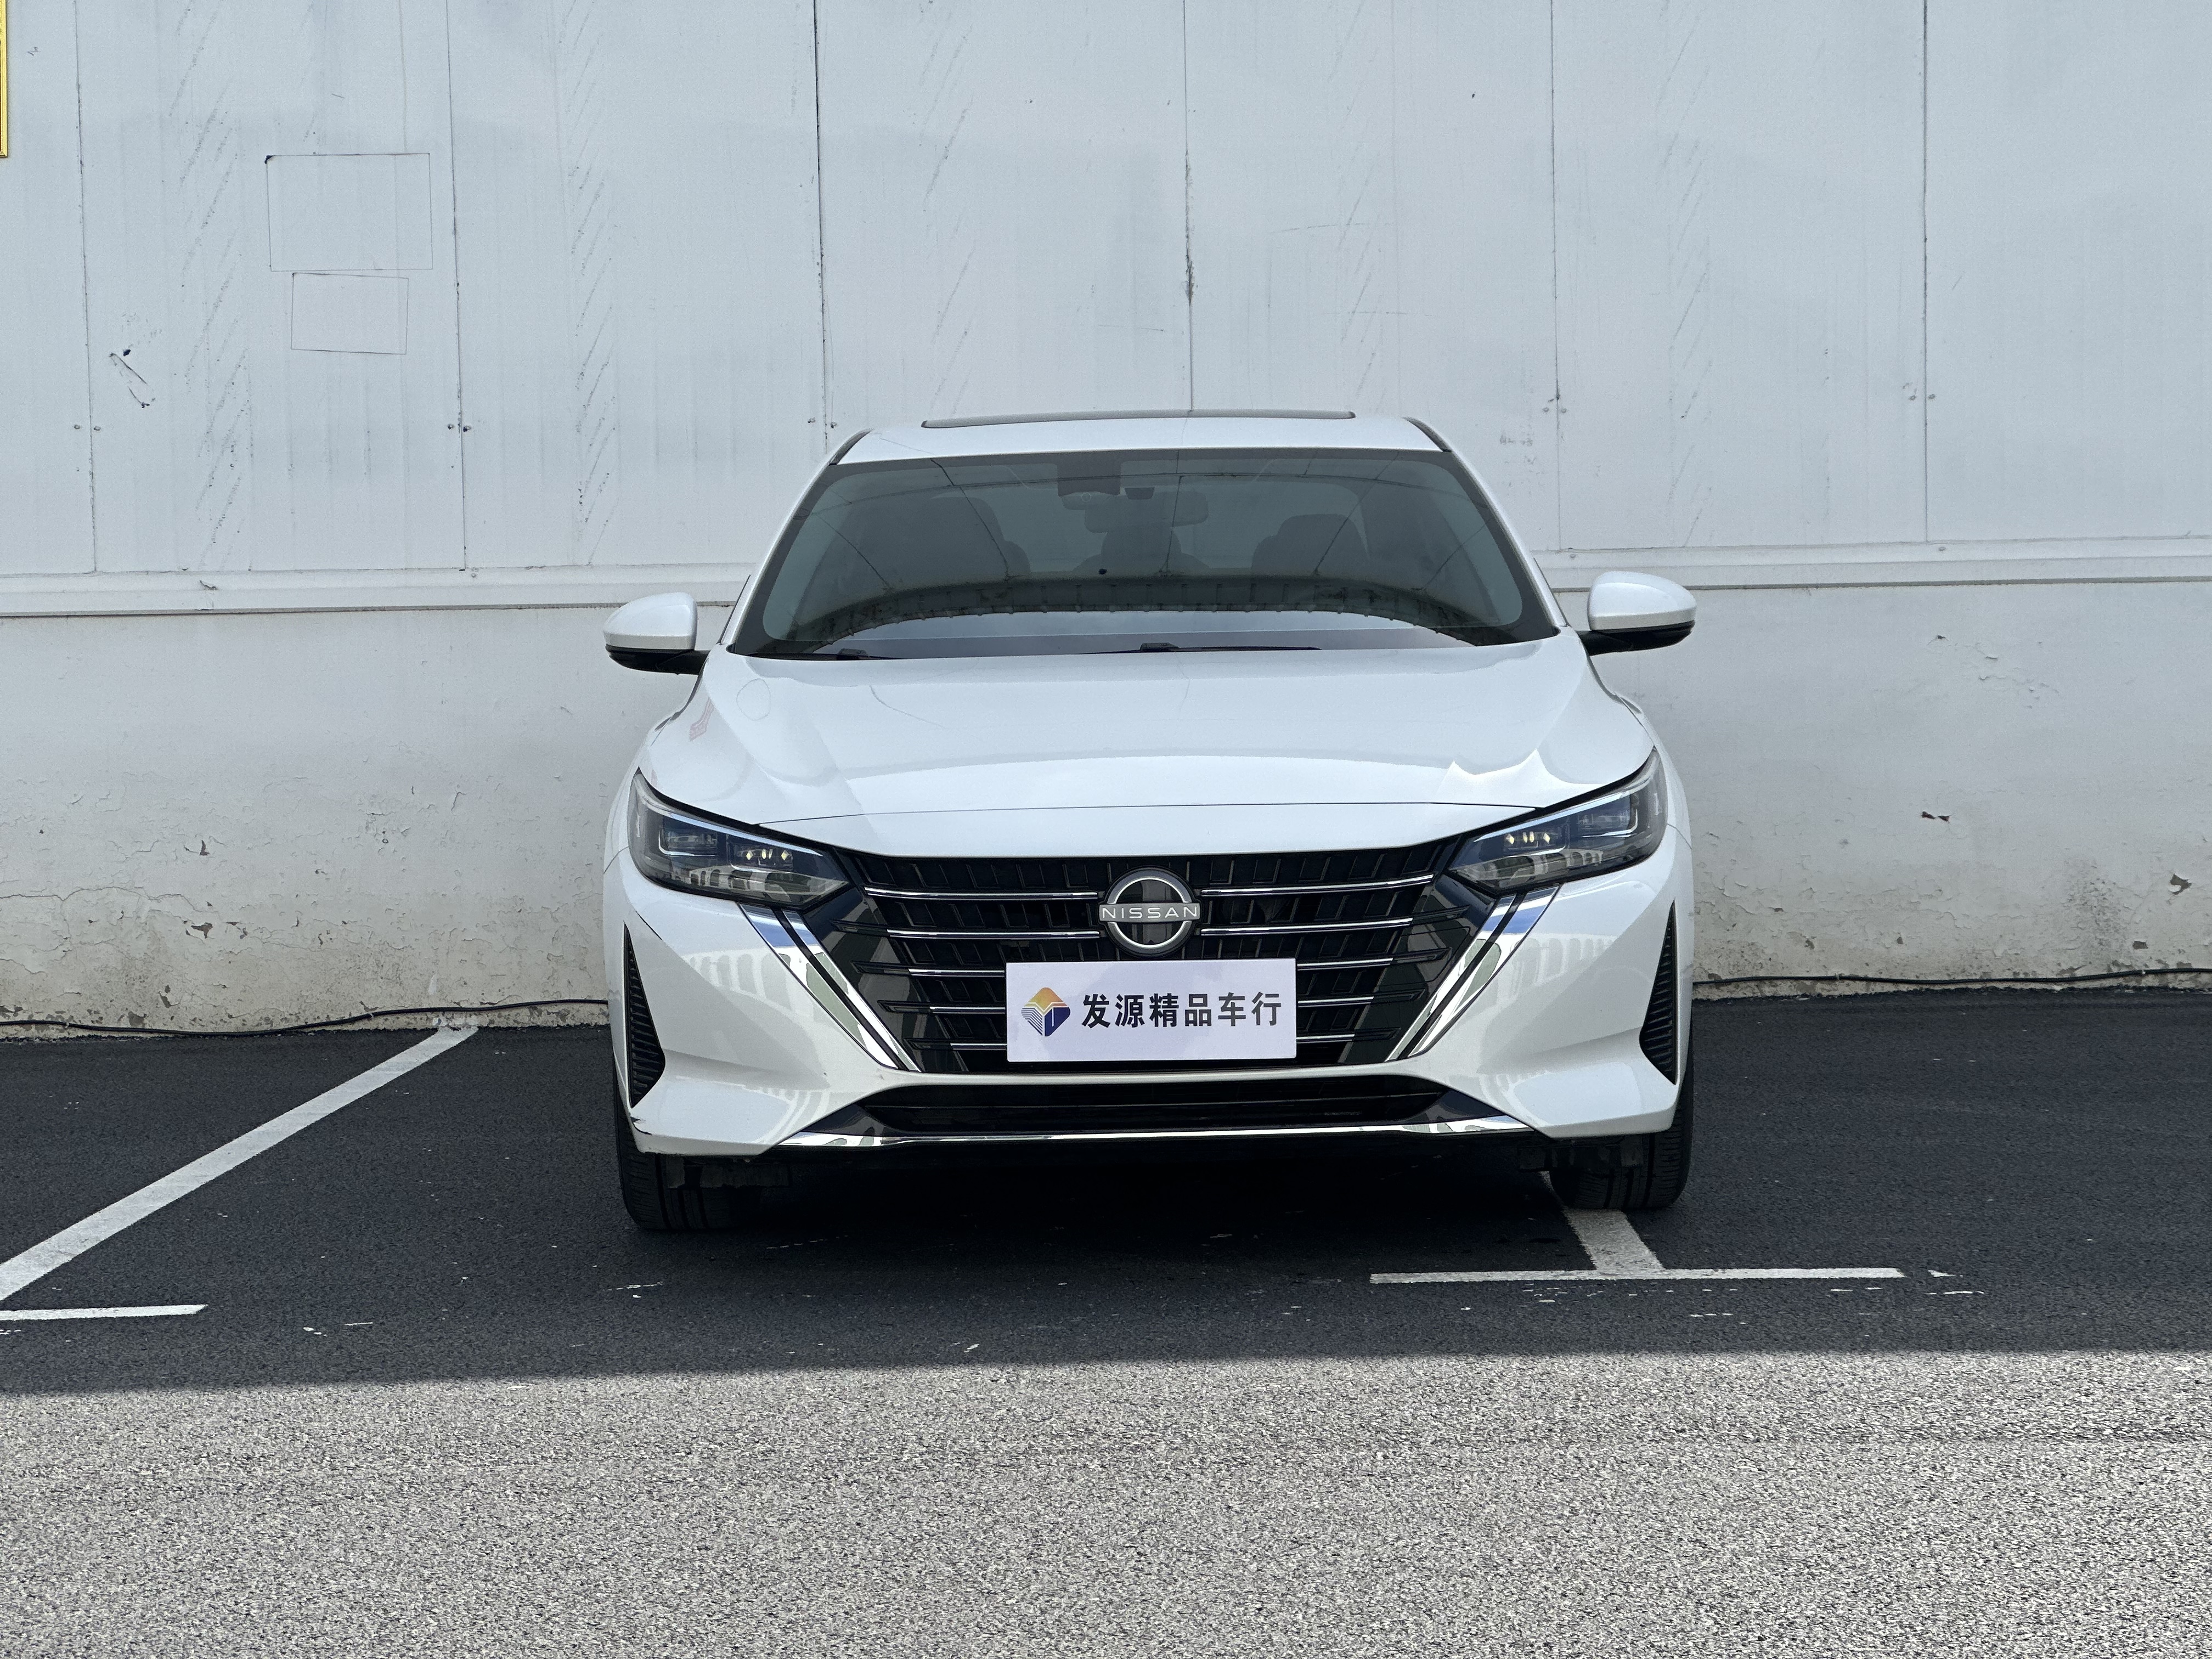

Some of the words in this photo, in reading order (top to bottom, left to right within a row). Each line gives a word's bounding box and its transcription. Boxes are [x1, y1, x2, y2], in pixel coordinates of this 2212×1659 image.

[1102, 906, 1197, 919] NISSAN
[1081, 991, 1282, 1028] 发源精品车行
